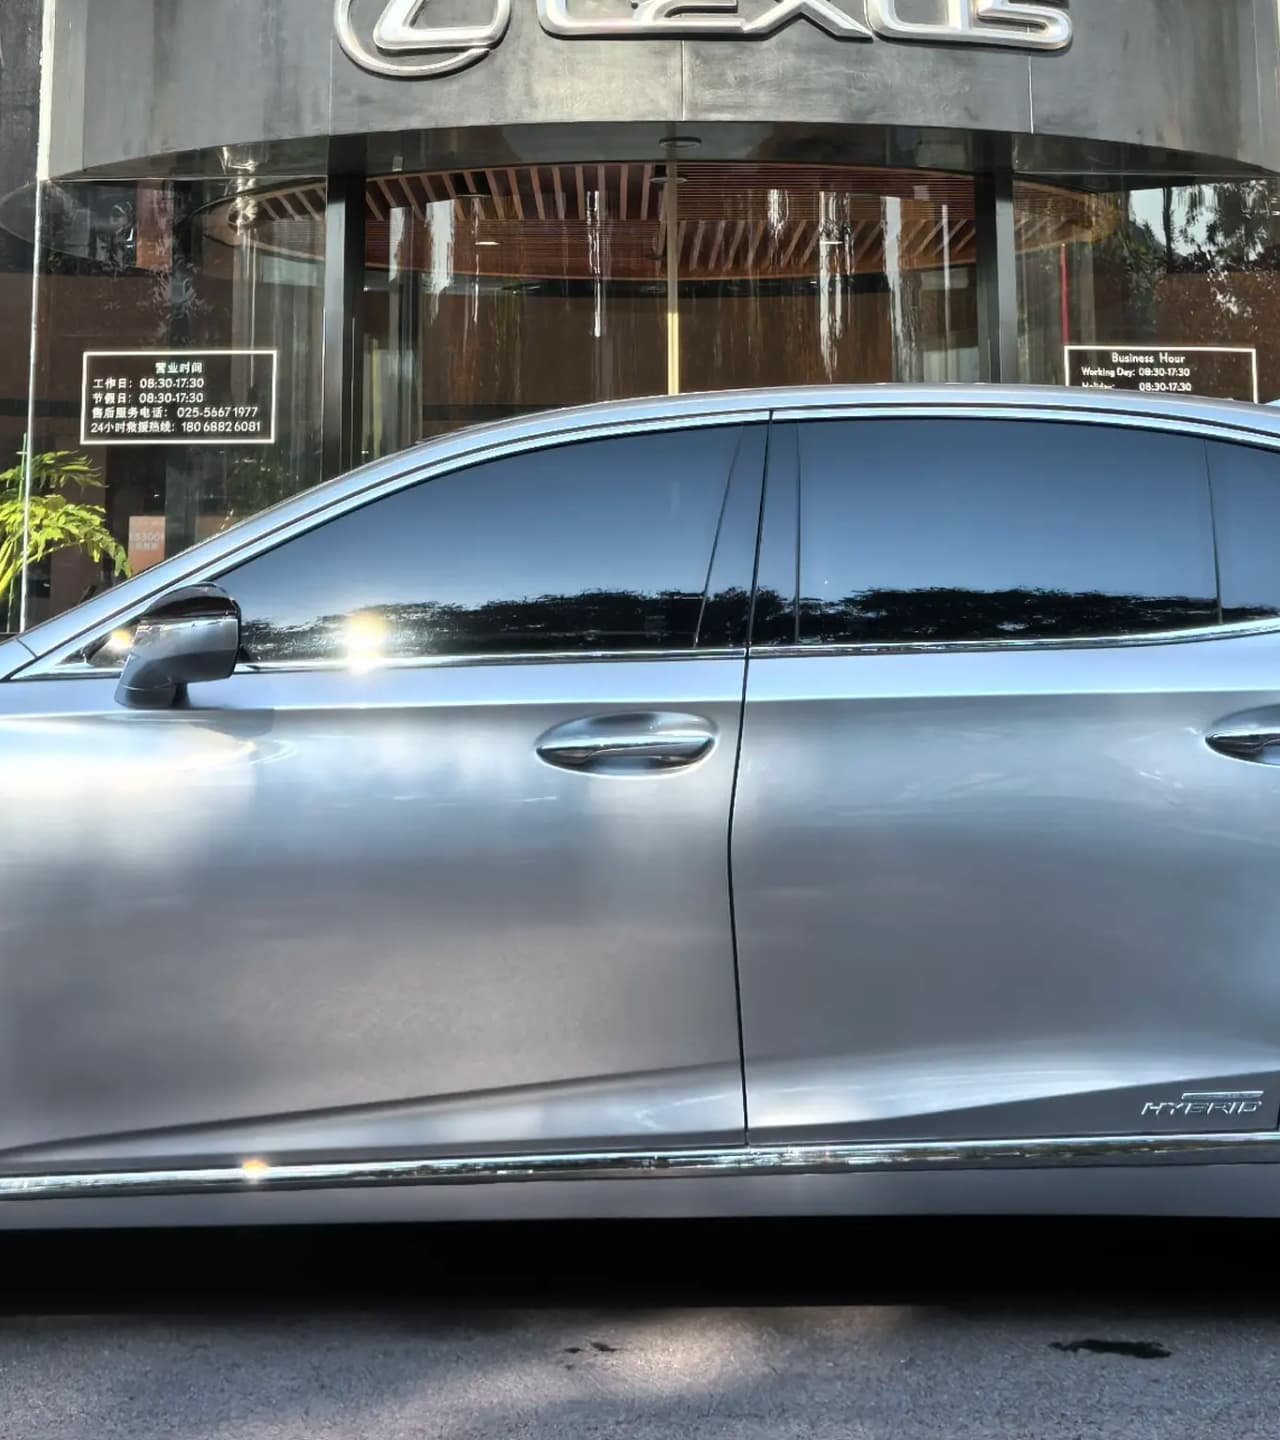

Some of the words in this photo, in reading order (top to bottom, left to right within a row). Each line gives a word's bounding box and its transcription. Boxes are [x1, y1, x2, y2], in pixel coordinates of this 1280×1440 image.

[1111, 352, 1154, 363] Business
[1159, 352, 1186, 363] Hour
[155, 362, 203, 374] 营业时间
[1081, 367, 1115, 378] Working
[1117, 367, 1136, 378] Day:
[1138, 367, 1191, 377] 08:30-17:30
[139, 378, 205, 389] 08:30-17:30
[1138, 382, 1192, 392] 08:30-17:30
[138, 392, 204, 404] 08:30-17:30
[1140, 1101, 1263, 1116] HYBRID
